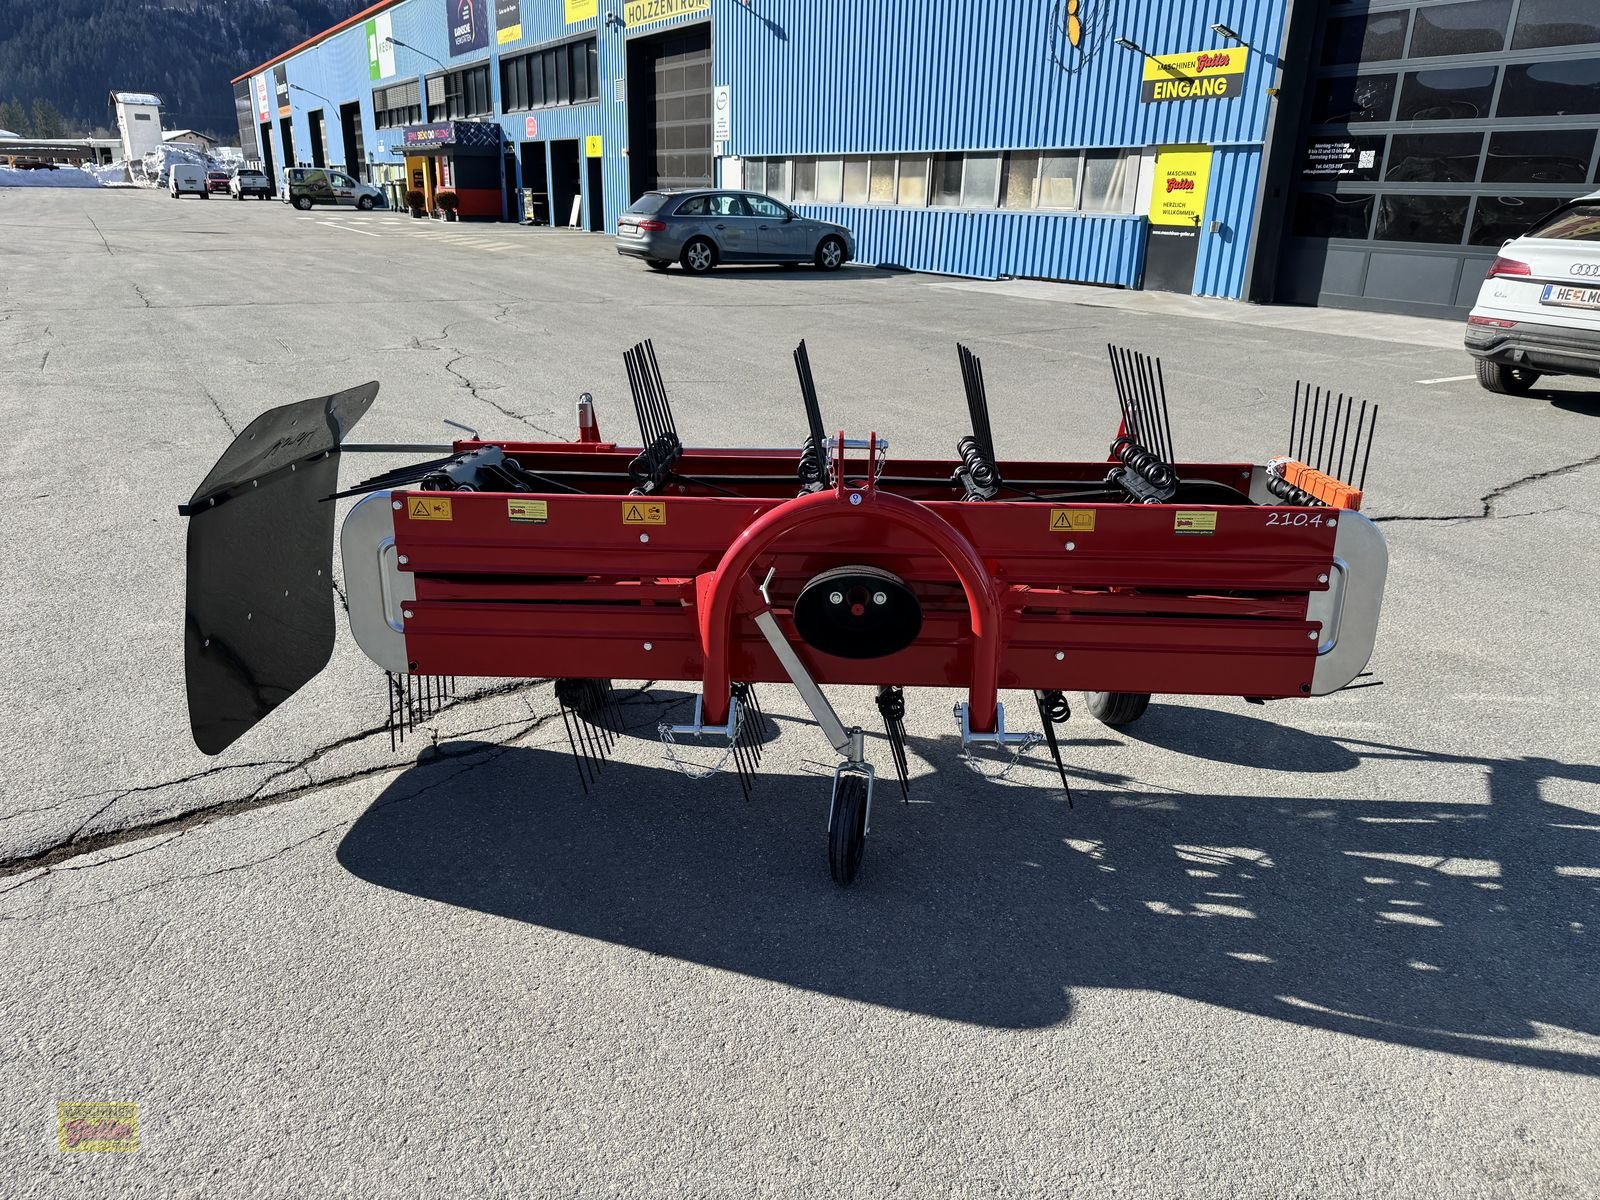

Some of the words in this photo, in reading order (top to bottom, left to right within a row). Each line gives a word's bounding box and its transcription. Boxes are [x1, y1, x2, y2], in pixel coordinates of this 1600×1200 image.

[1157, 61, 1196, 71] MASCHINEN
[1153, 78, 1227, 99] EINGANG
[1557, 288, 1574, 301] HE
